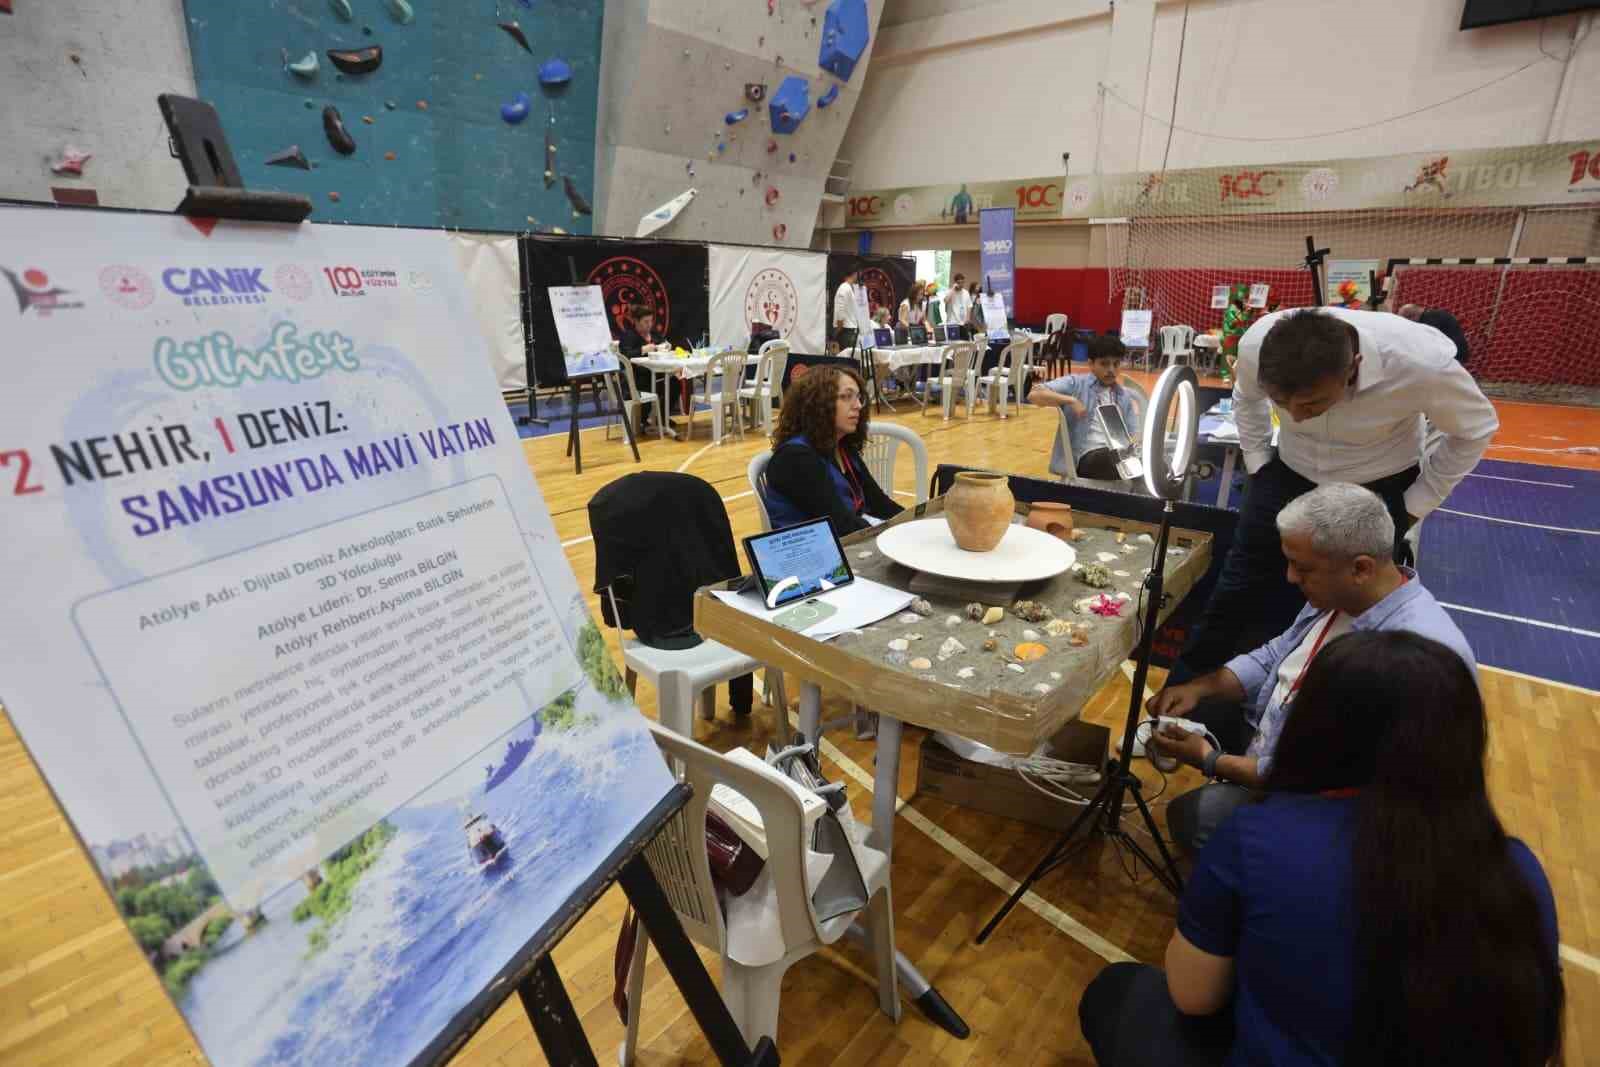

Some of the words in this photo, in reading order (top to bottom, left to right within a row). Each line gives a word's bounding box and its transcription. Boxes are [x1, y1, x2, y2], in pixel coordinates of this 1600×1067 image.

[323, 267, 361, 295] 100
[153, 321, 360, 391] bilimfest
[0, 448, 43, 496] 2
[50, 422, 211, 486] NEHİR,
[213, 415, 236, 453] 1
[237, 400, 348, 449] DENİZ:
[121, 453, 344, 537] SAMSUN'DA
[349, 436, 419, 480] MAVİ
[420, 418, 496, 459] VATAN
[136, 599, 201, 629] Atölye
[243, 568, 292, 594] Dijital
[293, 553, 335, 573] Deniz
[256, 611, 307, 639] Atölye
[309, 593, 354, 616] Lideri:
[357, 584, 376, 597] Dr.
[379, 569, 417, 589] Semra
[419, 552, 458, 572] BİLGİN
[317, 576, 338, 589] 3D
[425, 570, 464, 591] BİLGİN
